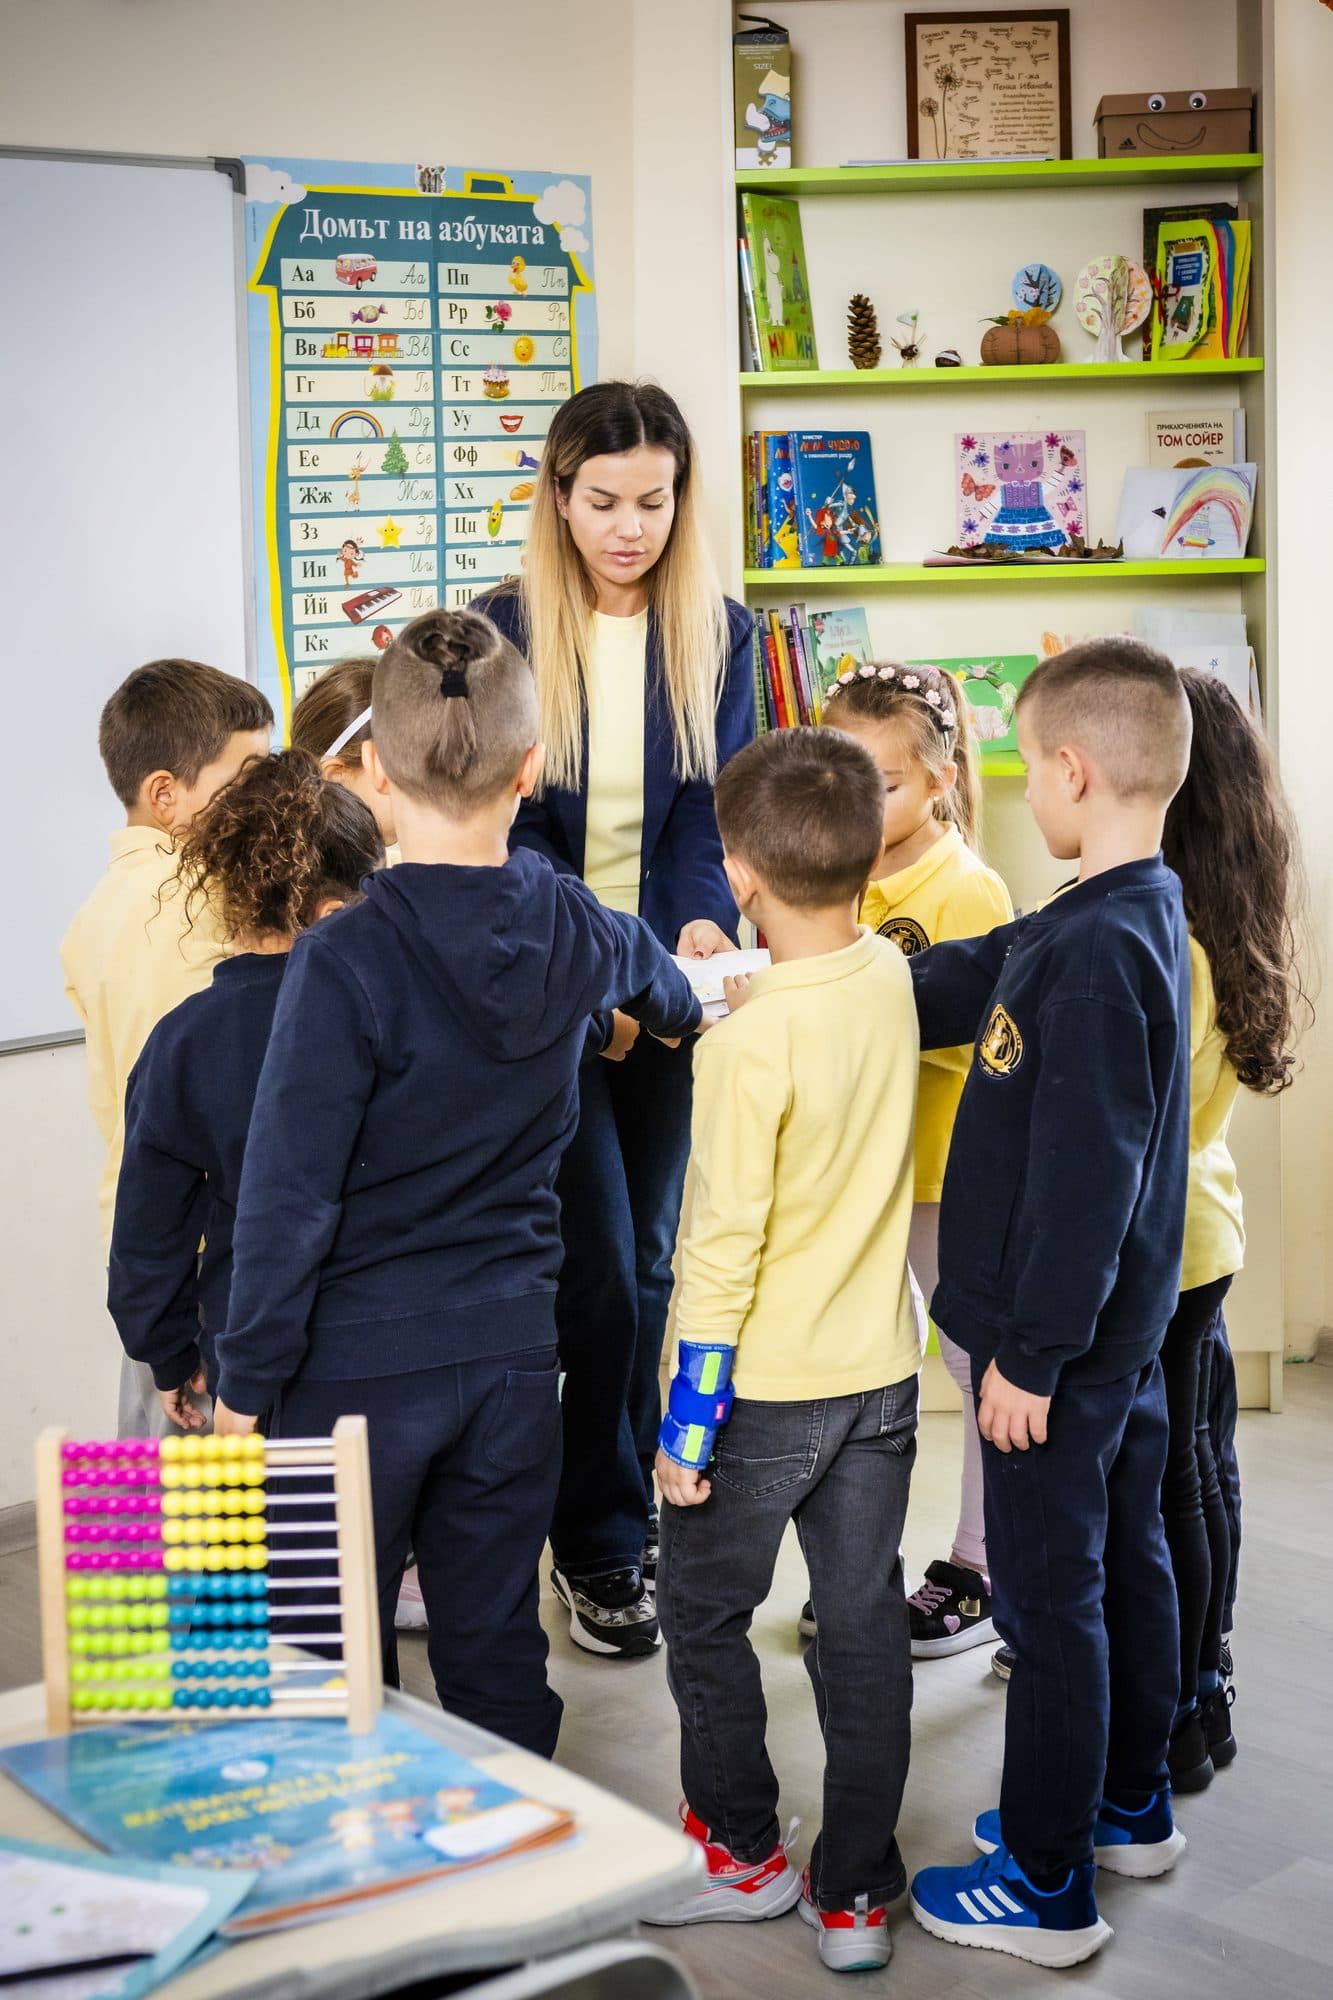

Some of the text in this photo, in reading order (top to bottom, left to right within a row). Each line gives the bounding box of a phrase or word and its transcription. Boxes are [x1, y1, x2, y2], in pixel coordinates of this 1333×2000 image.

[299, 208, 390, 245] Домът
[398, 220, 432, 241] на
[439, 215, 545, 251] азбуката
[291, 264, 426, 285] Аа Аа
[447, 268, 469, 286] Пп
[293, 299, 427, 321] Бб Бб
[448, 302, 567, 329] Рр Рр
[295, 335, 430, 357] Вв Вв
[450, 337, 568, 358] Сс Сс
[296, 375, 315, 393] Гг
[451, 375, 471, 392] Тт
[296, 411, 321, 433] Дд
[453, 410, 472, 432] Уу
[1157, 431, 1224, 447] ТОМ СОЙЕР
[299, 443, 433, 467] Ее Ее
[453, 446, 478, 467] Фф
[299, 486, 332, 505] Жж
[454, 482, 475, 500] Хх
[300, 522, 319, 540] Зз
[455, 516, 477, 535] Цц
[302, 560, 327, 578] Ии
[455, 553, 476, 570] Чч
[304, 594, 328, 615] Йй
[305, 634, 329, 653] Кк
